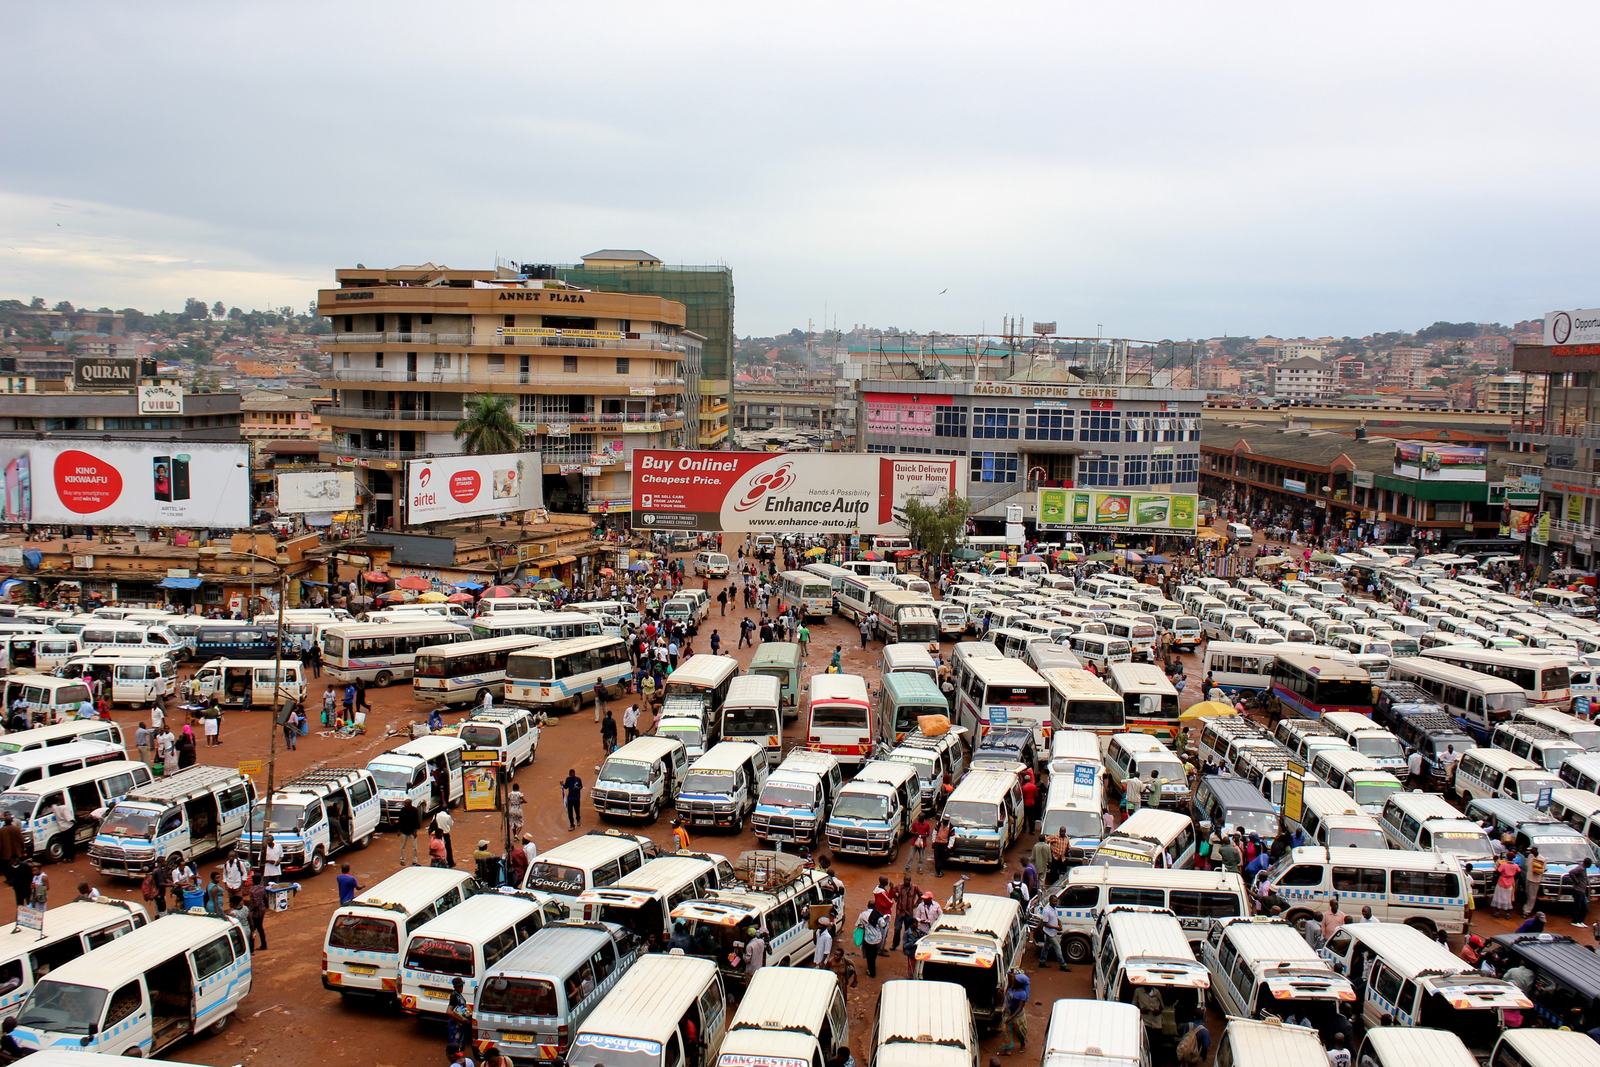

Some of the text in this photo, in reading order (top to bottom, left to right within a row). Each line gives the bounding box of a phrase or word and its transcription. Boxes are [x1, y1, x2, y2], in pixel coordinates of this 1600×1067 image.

[499, 292, 585, 303] ANNET PLAZA
[1551, 346, 1572, 357] PARK
[81, 365, 131, 382] QURAN
[144, 387, 177, 399] Pioneer
[973, 385, 1118, 398] MAGOBA SHOPPING CENTRE
[148, 401, 174, 410] VIEW
[641, 456, 739, 473] Buy Online!
[894, 463, 949, 475] Quick Delivery
[75, 467, 97, 475] KINO
[65, 475, 108, 484] KIKWAAFU
[641, 474, 722, 485] Cheapest Price.
[896, 473, 905, 481] to
[925, 473, 947, 482] Home
[808, 488, 829, 496] Hands
[836, 489, 871, 497] Possibility
[413, 492, 436, 507] airtel
[765, 496, 870, 514] Enhance Auto
[748, 518, 857, 528] www.enhance-auto.jp
[1075, 766, 1094, 775] JINJA
[1075, 776, 1093, 785] 6000
[1098, 847, 1116, 856] HARD
[1115, 850, 1133, 858] WORK
[579, 1034, 658, 1051] KOLOLO SOCCER ACADEMY
[722, 1056, 802, 1067] MANCHESTER
